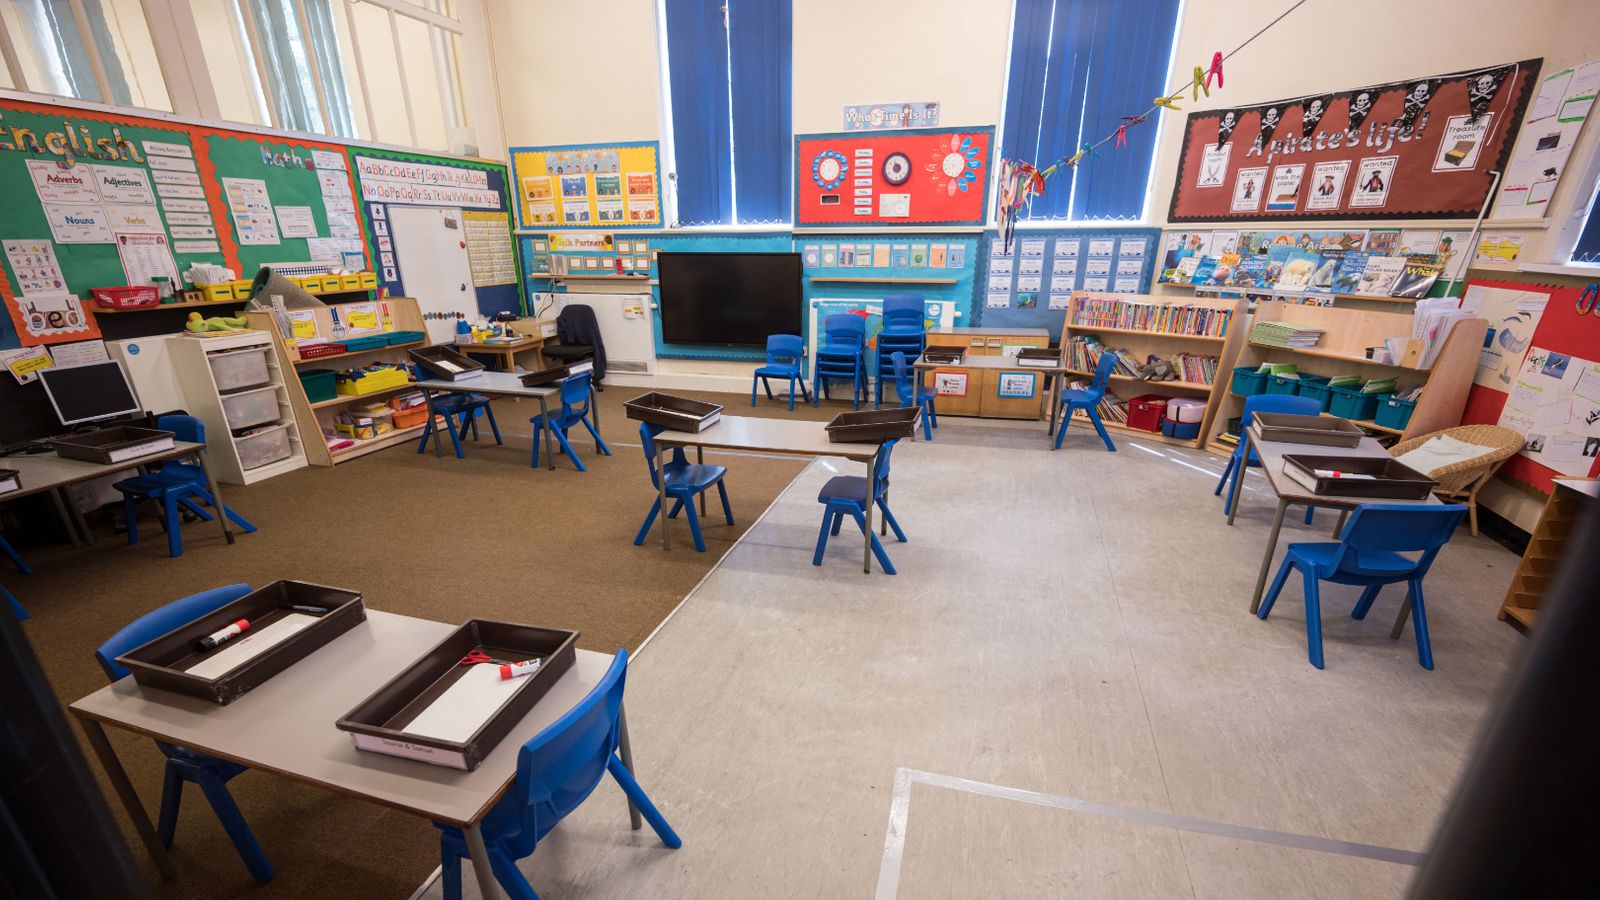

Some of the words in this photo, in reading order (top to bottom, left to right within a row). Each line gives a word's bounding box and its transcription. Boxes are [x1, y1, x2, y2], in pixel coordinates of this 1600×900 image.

[880, 109, 905, 122] Time
[908, 109, 919, 121] Is
[921, 107, 938, 120] It?
[1448, 125, 1486, 133] Treasure
[1245, 132, 1263, 158] A
[1266, 127, 1361, 164] pirate's
[1365, 109, 1431, 155] life!
[258, 144, 315, 171] Maths
[1317, 164, 1346, 172] wanted
[46, 174, 84, 185] Adverbs
[103, 176, 142, 188] Adjectives
[64, 215, 96, 225] Nouns
[124, 215, 146, 225] Verbs
[574, 238, 606, 247] Partners
